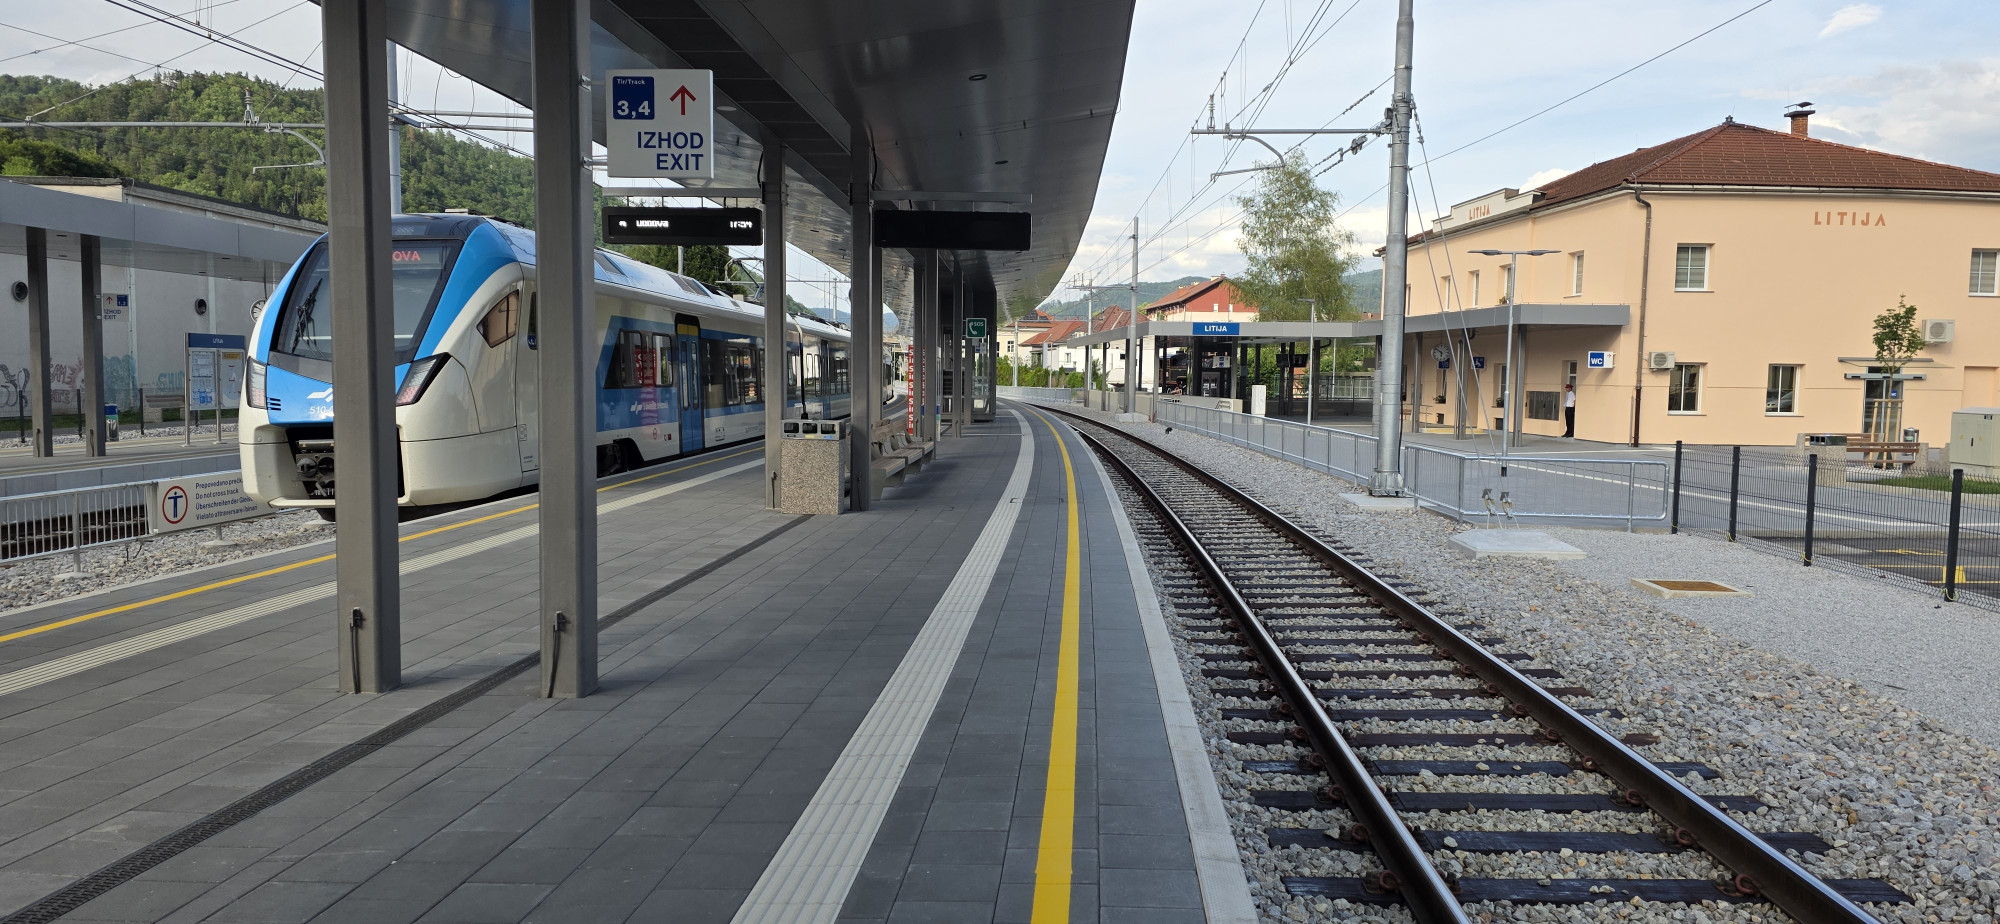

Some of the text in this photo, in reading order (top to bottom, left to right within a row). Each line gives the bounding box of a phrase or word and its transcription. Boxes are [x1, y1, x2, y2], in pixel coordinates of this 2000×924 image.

[617, 100, 651, 119] 3,4
[637, 131, 704, 149] IZHOD
[656, 153, 704, 171] EXIT
[1469, 203, 1491, 221] LITIJA
[1814, 211, 1886, 227] LITIJA
[1590, 357, 1603, 365] WC
[226, 487, 239, 495] track
